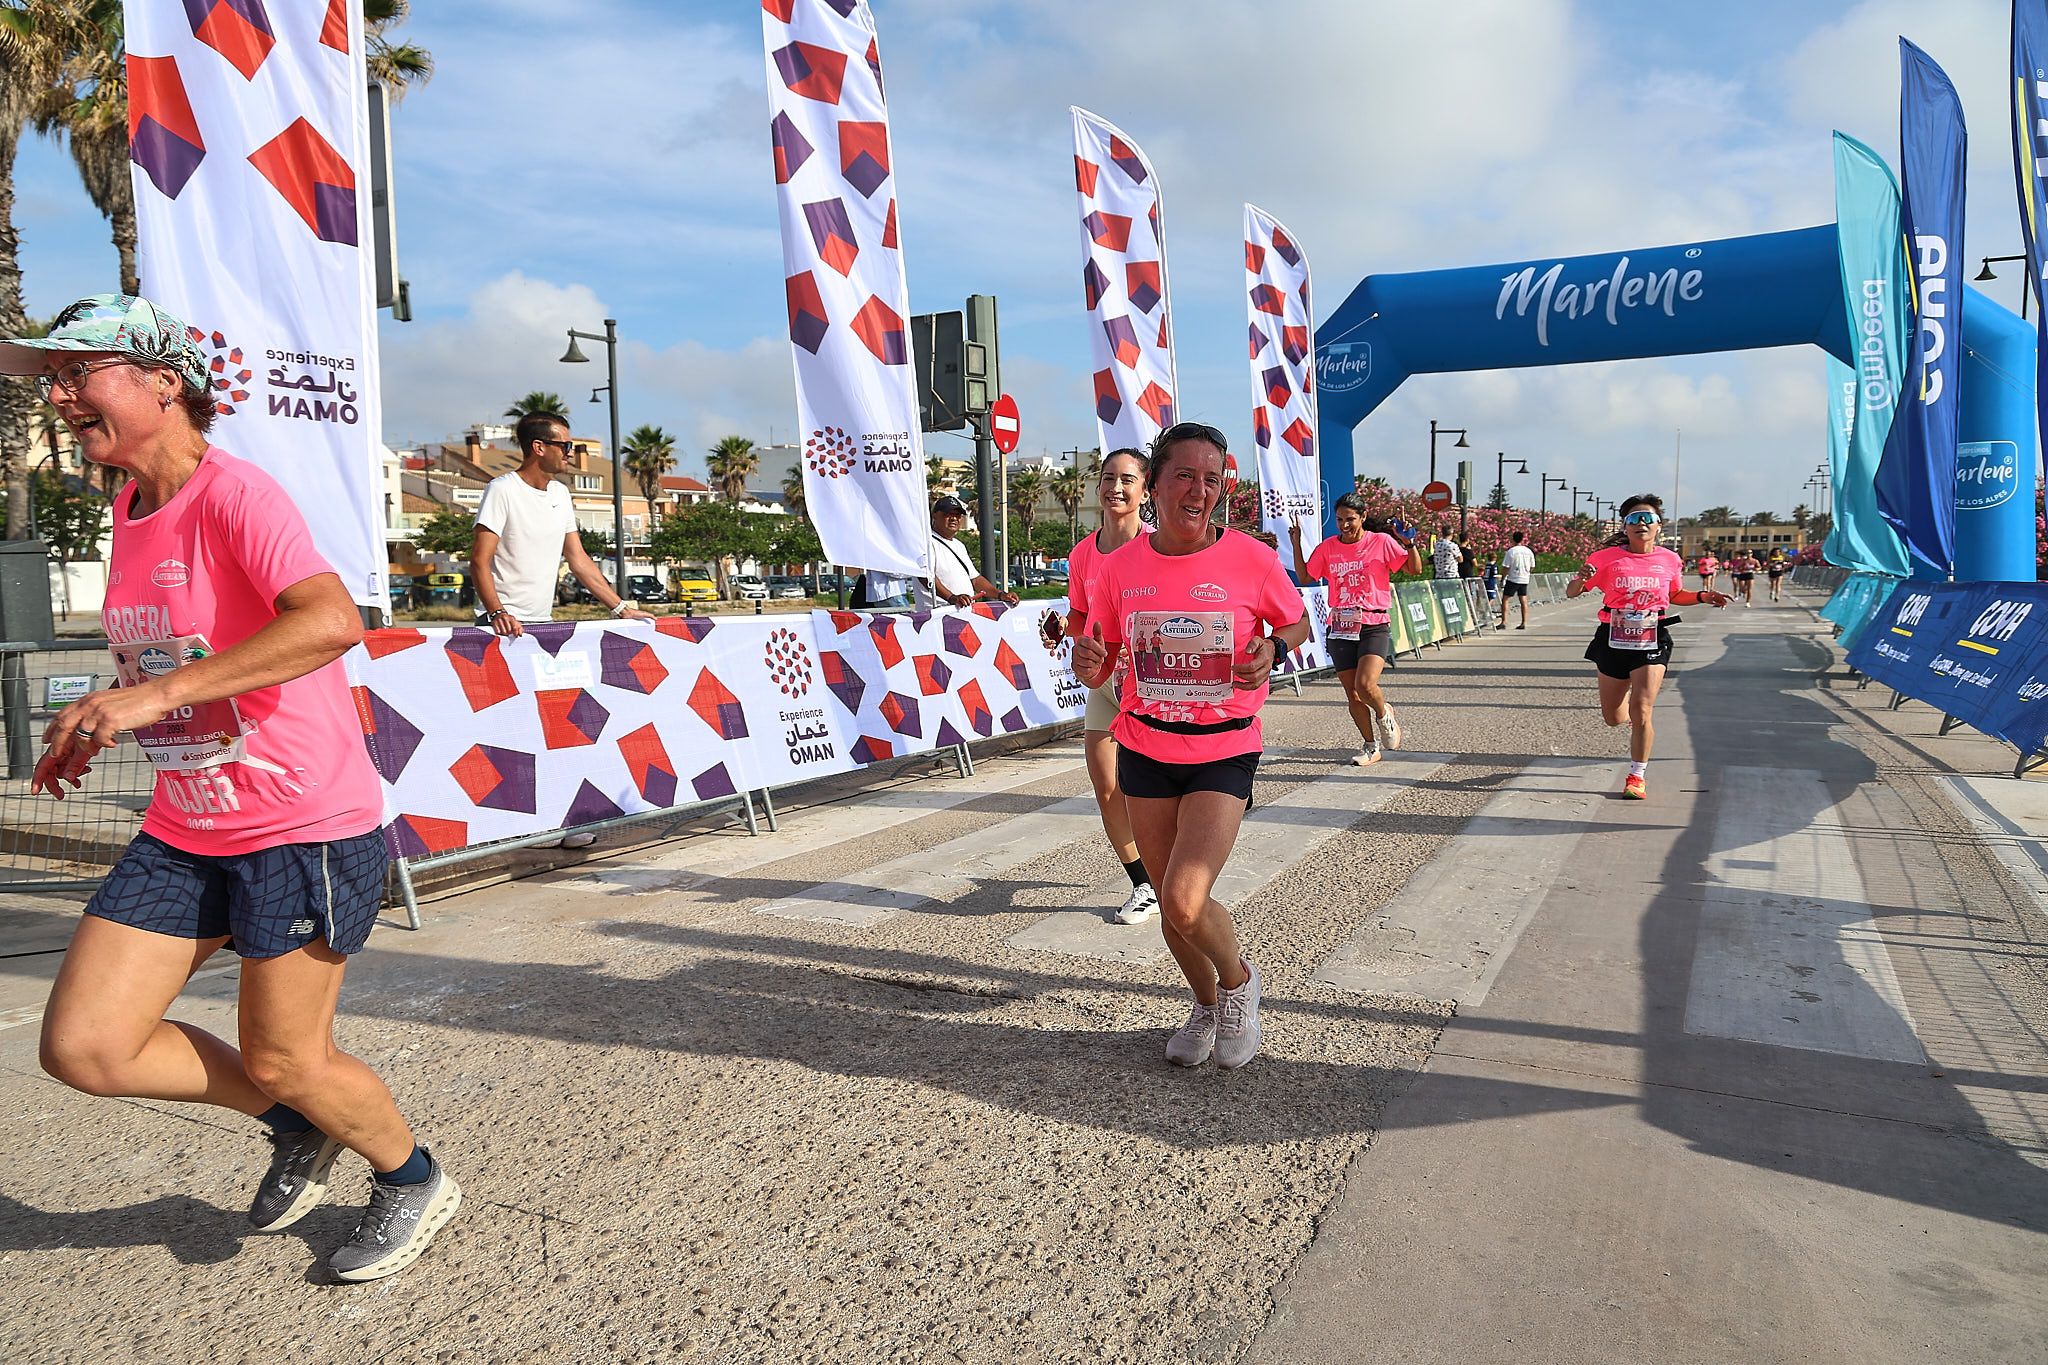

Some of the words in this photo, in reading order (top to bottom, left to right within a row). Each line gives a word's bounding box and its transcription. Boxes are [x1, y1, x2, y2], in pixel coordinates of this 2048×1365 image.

[1496, 256, 1703, 346] Marlene
[1315, 354, 1367, 379] Marlene
[1956, 457, 2013, 484] arlene
[1985, 489, 2008, 503] ALPES
[1329, 561, 1364, 574] CARRERA
[1615, 577, 1661, 588] CARRERA
[1122, 585, 1157, 599] OYSHO
[1192, 589, 1226, 600] ASTURIANA
[1896, 593, 1932, 626] GOYA
[103, 604, 175, 644] RRERA
[1968, 599, 2033, 642] GOYA
[1162, 624, 1202, 634] ASTURIANA
[1163, 653, 1202, 668] 016
[1057, 692, 1087, 709] OMAN
[160, 704, 194, 720] 16
[779, 707, 824, 723] Experience
[166, 724, 186, 734] 2093
[159, 737, 166, 745] DE
[166, 737, 173, 745] LA
[152, 752, 170, 763] SHO
[190, 747, 232, 761] Santander
[789, 742, 835, 765] OMAN
